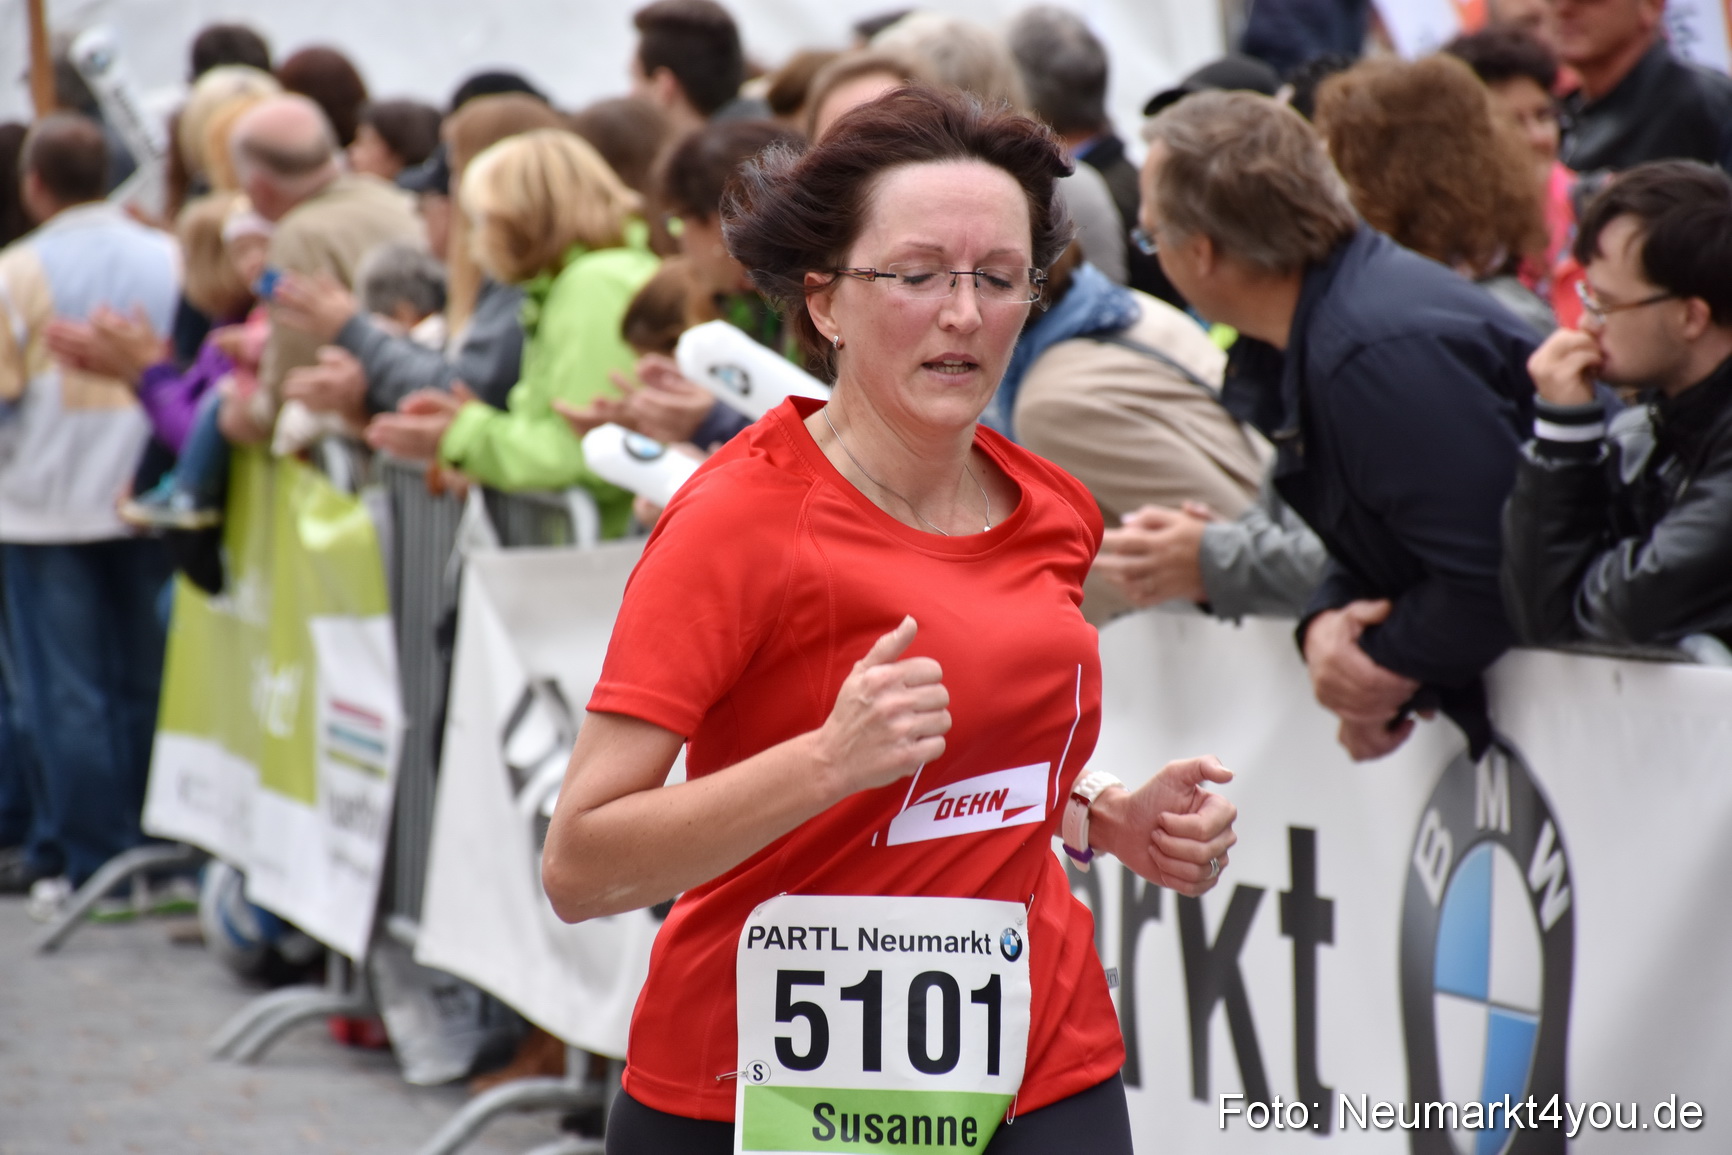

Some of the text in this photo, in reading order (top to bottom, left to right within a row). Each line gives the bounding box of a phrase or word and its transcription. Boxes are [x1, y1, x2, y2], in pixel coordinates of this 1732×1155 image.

[933, 788, 1010, 822] DEHN
[1414, 747, 1571, 933] BMW
[747, 925, 992, 955] PARTL Neumarkt
[774, 969, 1002, 1076] 5101
[752, 1063, 764, 1082] S
[812, 1102, 978, 1148] Susanne
